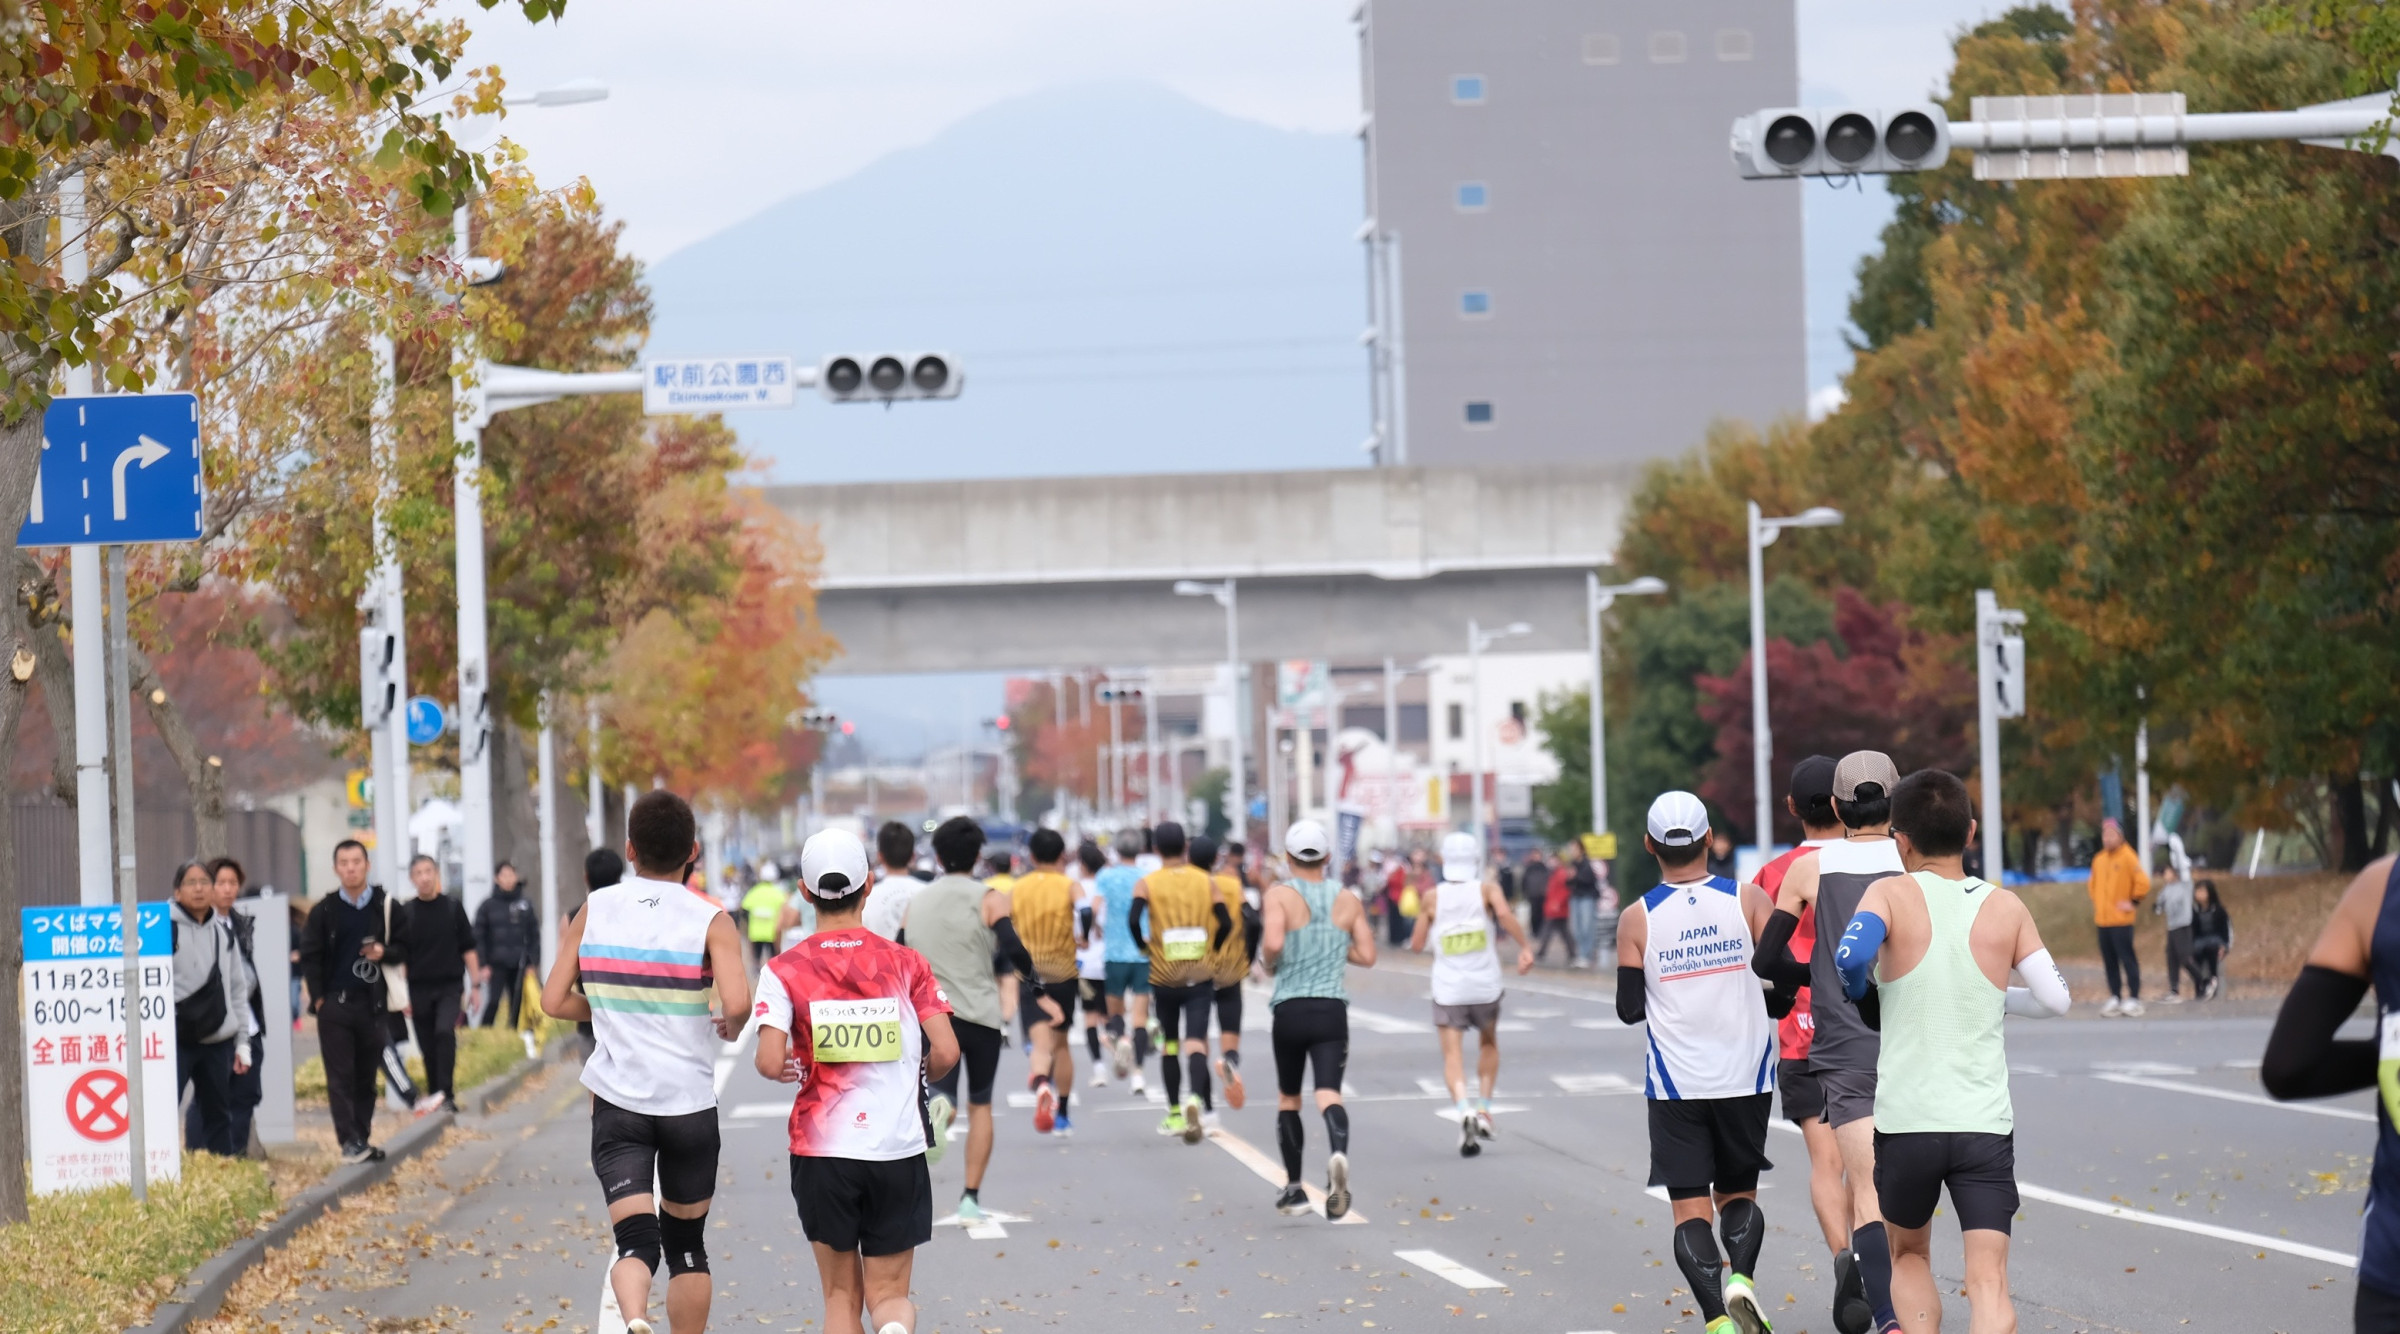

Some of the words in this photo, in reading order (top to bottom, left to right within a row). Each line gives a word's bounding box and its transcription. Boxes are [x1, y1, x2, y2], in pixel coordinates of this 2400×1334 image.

[654, 362, 786, 387] 駅前公園西
[32, 910, 160, 933] つくばマラン
[51, 934, 143, 956] 開催のた
[820, 939, 863, 949] docomo
[1679, 925, 1718, 942] JAPAN
[1659, 948, 1684, 962] FUN
[1687, 939, 1743, 957] RUNNERS
[31, 966, 171, 991] 11月23日日)
[817, 1023, 882, 1048] 2070
[45, 1150, 170, 1166] ご迷惑をおかけしすが
